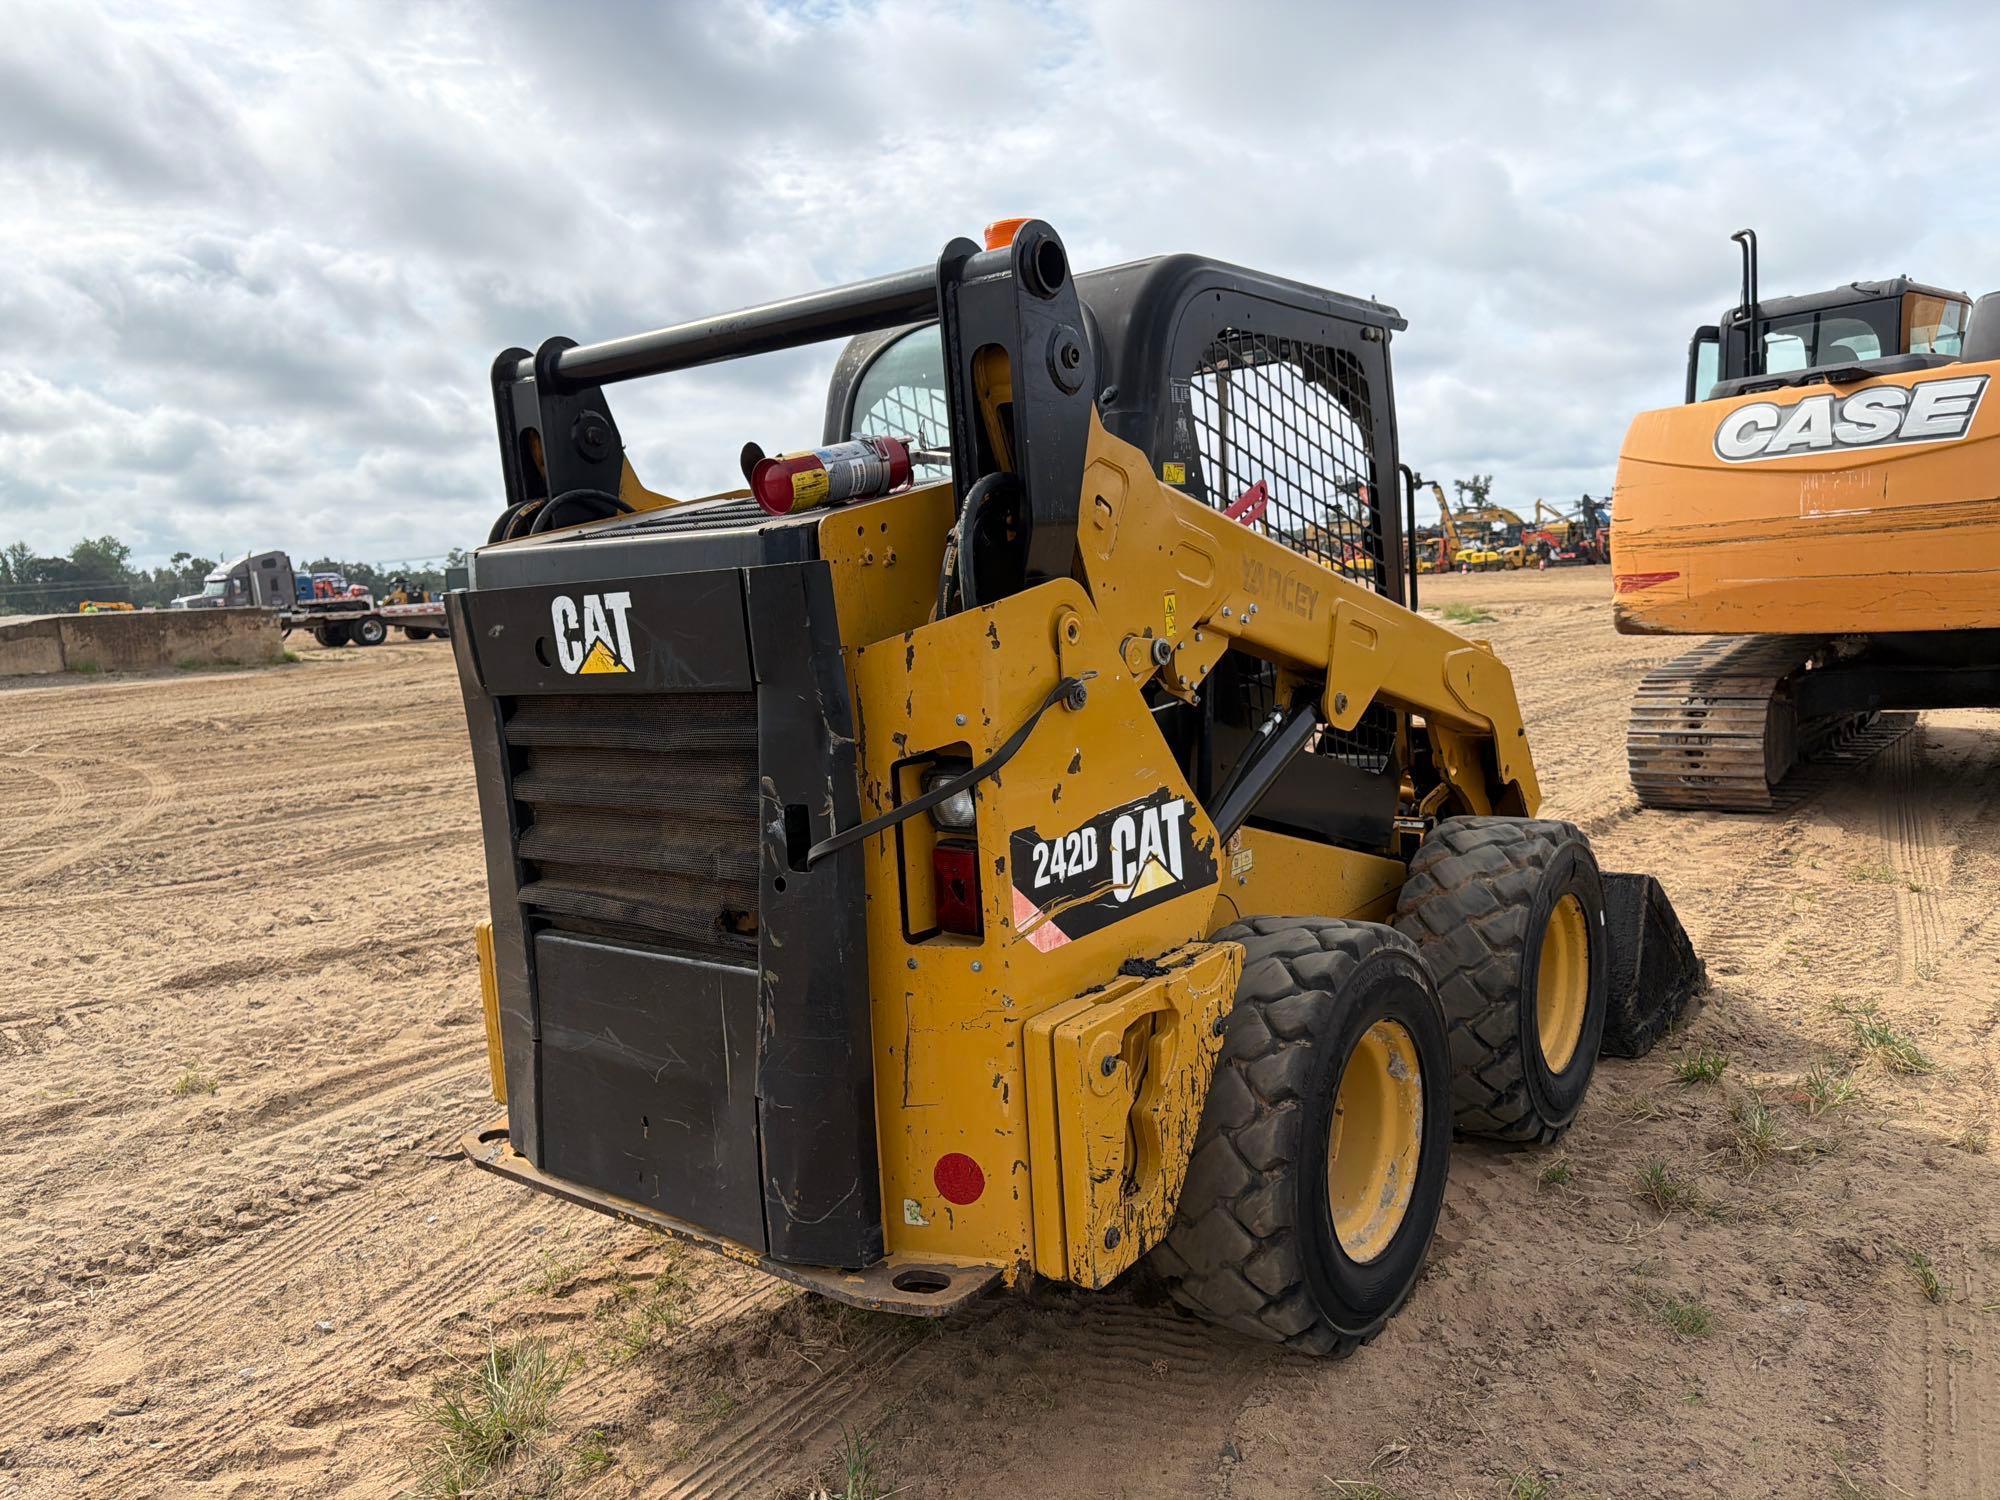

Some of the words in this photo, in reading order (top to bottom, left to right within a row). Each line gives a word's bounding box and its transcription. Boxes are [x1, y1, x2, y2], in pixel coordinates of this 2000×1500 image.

[1714, 376, 1986, 459] CASE
[551, 591, 636, 675] CAT
[1032, 826, 1098, 889] 242D
[1110, 799, 1185, 903] CAT
